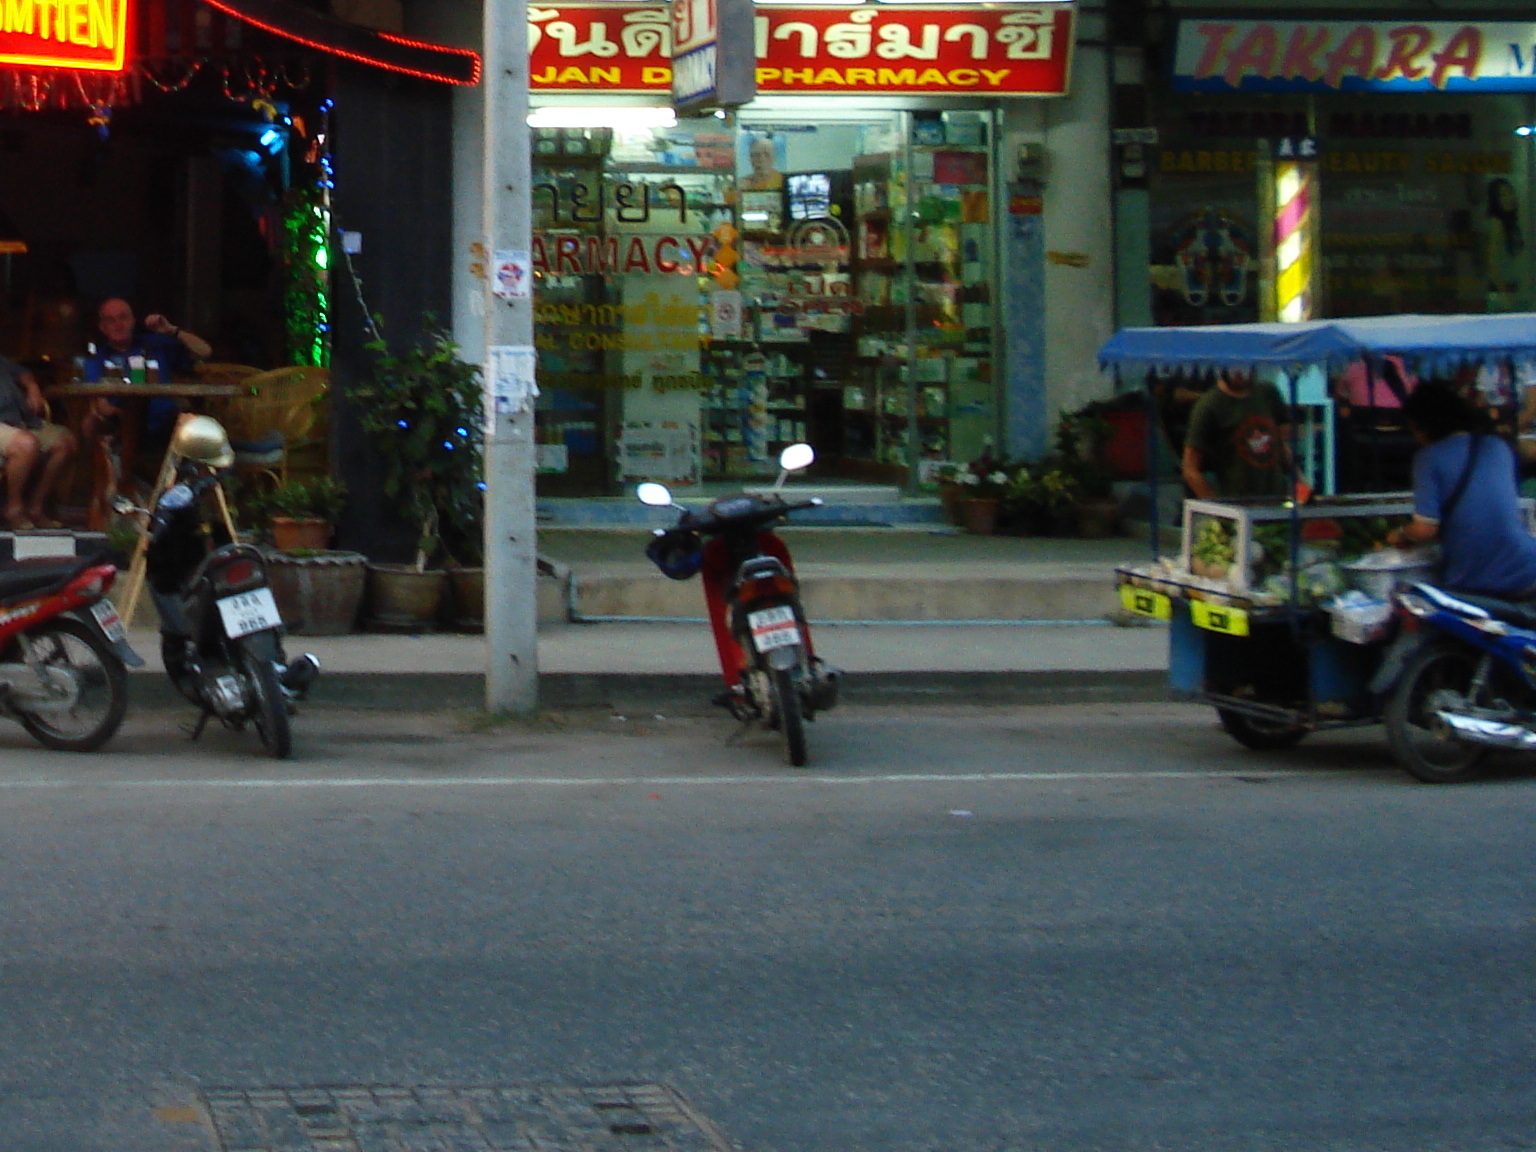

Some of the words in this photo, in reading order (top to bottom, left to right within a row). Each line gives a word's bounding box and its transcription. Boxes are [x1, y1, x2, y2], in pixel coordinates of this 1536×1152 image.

[531, 65, 622, 85] JAN
[754, 66, 1012, 86] PHARMACY
[1192, 23, 1485, 90] TAKARA
[1159, 150, 1259, 173] BARBE
[532, 181, 688, 224] ายยา
[531, 235, 713, 274] ARMACY
